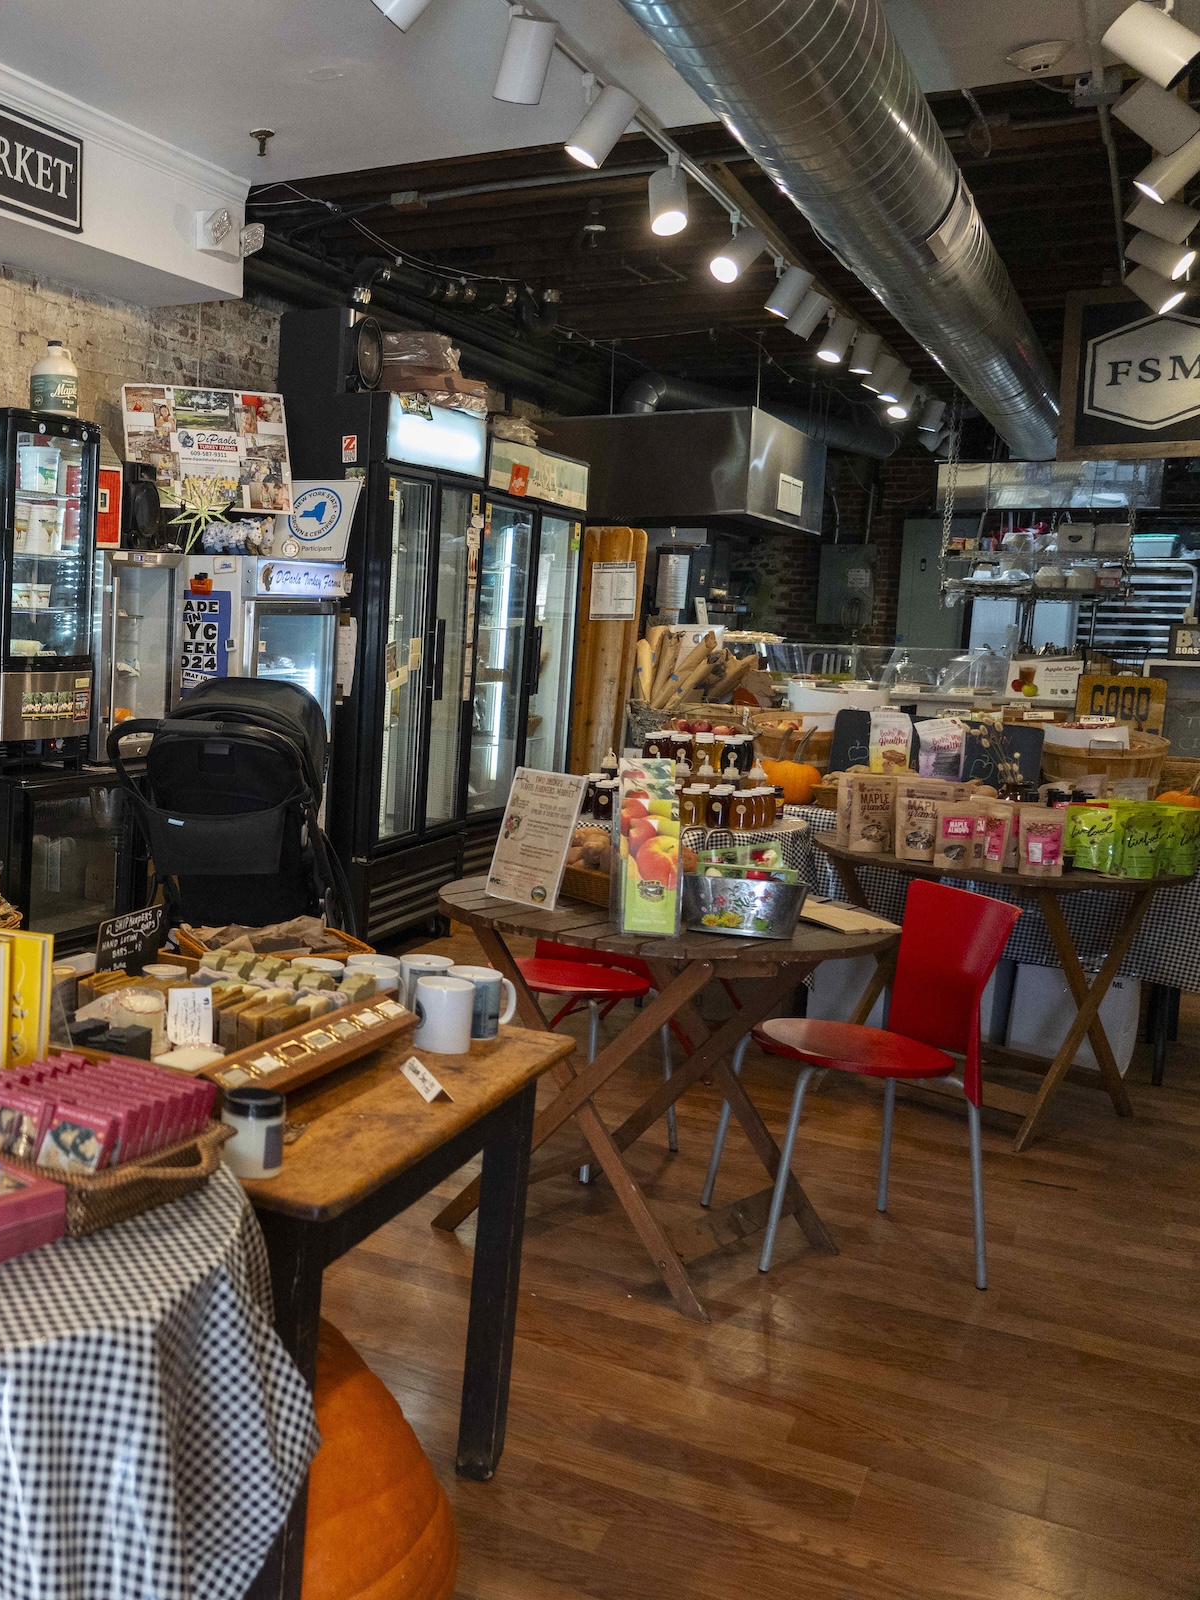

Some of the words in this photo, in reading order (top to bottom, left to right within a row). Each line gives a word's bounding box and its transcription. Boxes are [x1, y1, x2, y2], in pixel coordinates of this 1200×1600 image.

[1105, 355, 1200, 387] FSM
[196, 432, 237, 445] DiPaola
[295, 496, 308, 510] NEW
[308, 491, 325, 499] YORK
[326, 493, 338, 509] STATE
[291, 515, 305, 536] GROWN
[309, 514, 336, 537] CERTIFIED
[276, 570, 301, 584] DiPaola
[303, 571, 322, 589] Turkey
[323, 574, 341, 589] Farms
[183, 601, 218, 613] ADE
[187, 613, 201, 623] IN
[185, 623, 217, 640] YC
[183, 642, 216, 654] EEK
[181, 656, 216, 669] 024
[879, 737, 908, 746] Healthy
[860, 793, 889, 803] MAPLE
[860, 804, 890, 816] granola
[907, 800, 937, 811] MAPL
[102, 939, 118, 951] HAND
[120, 933, 138, 946] LOTION
